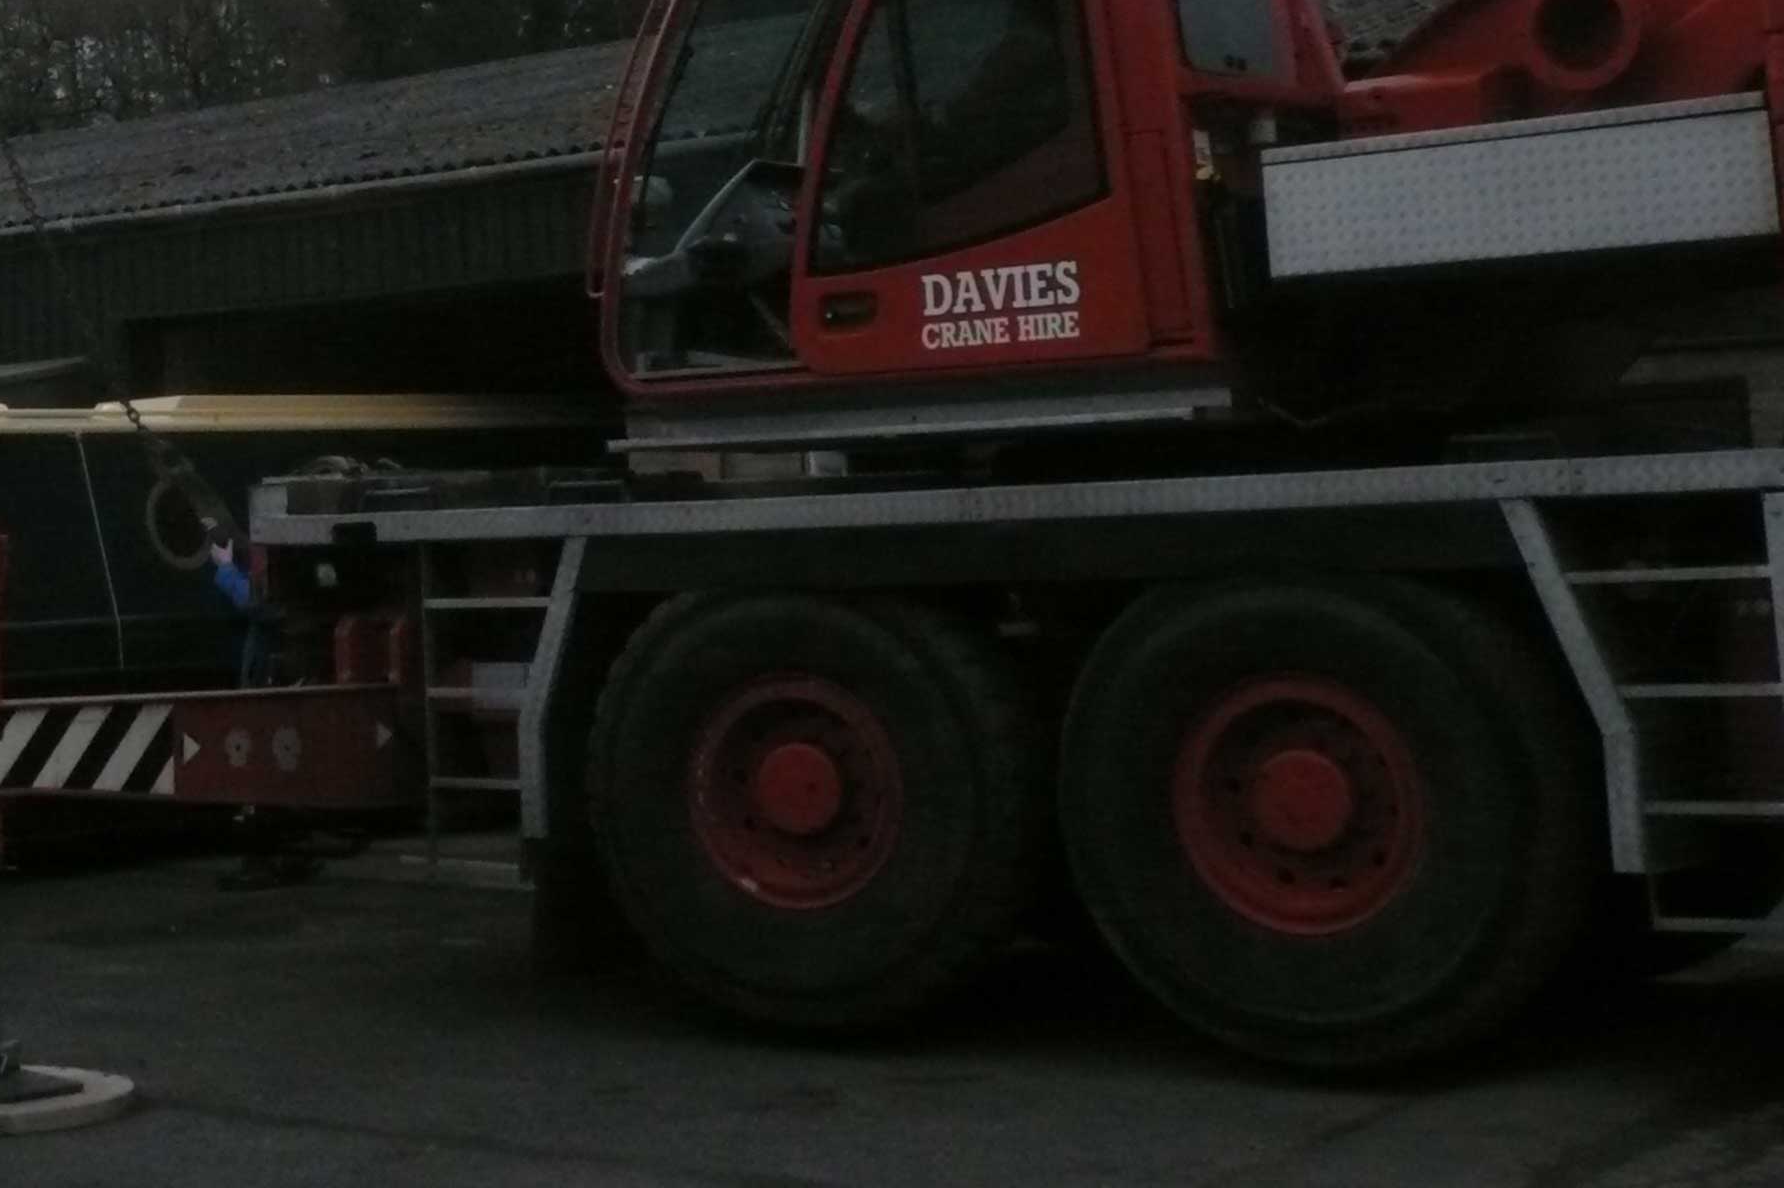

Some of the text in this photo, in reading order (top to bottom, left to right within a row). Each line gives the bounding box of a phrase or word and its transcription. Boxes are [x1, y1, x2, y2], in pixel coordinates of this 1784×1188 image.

[921, 260, 1080, 316] DAVIES
[921, 311, 1080, 349] CRANE HIRE
